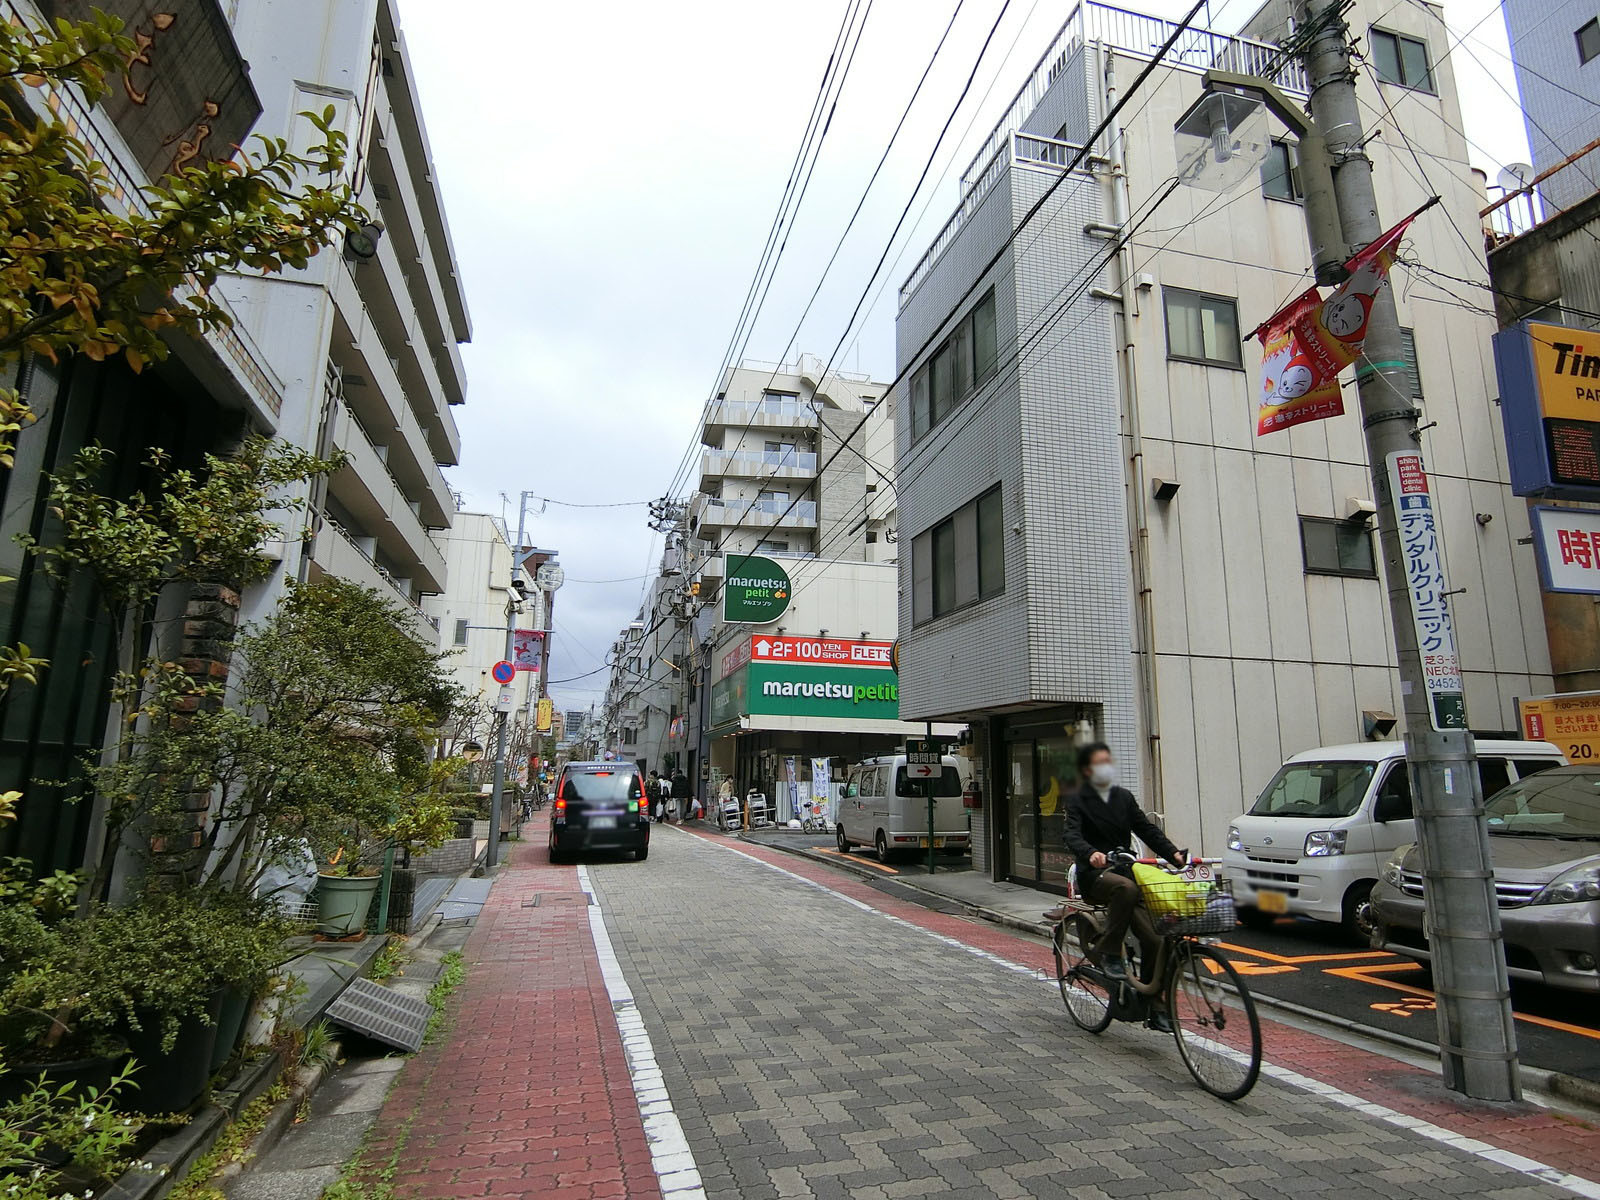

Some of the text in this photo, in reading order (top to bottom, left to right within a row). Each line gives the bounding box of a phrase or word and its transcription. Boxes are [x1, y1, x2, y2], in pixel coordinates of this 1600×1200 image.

[1557, 529, 1600, 569] 時
[728, 577, 787, 589] maruetsu
[1401, 513, 1442, 651] デンタルクリニック
[745, 589, 770, 599] petit
[772, 641, 821, 658] 2F 100
[822, 651, 849, 659] SHOP
[763, 681, 898, 704] maruetsu petit
[909, 753, 938, 763] 時間貸
